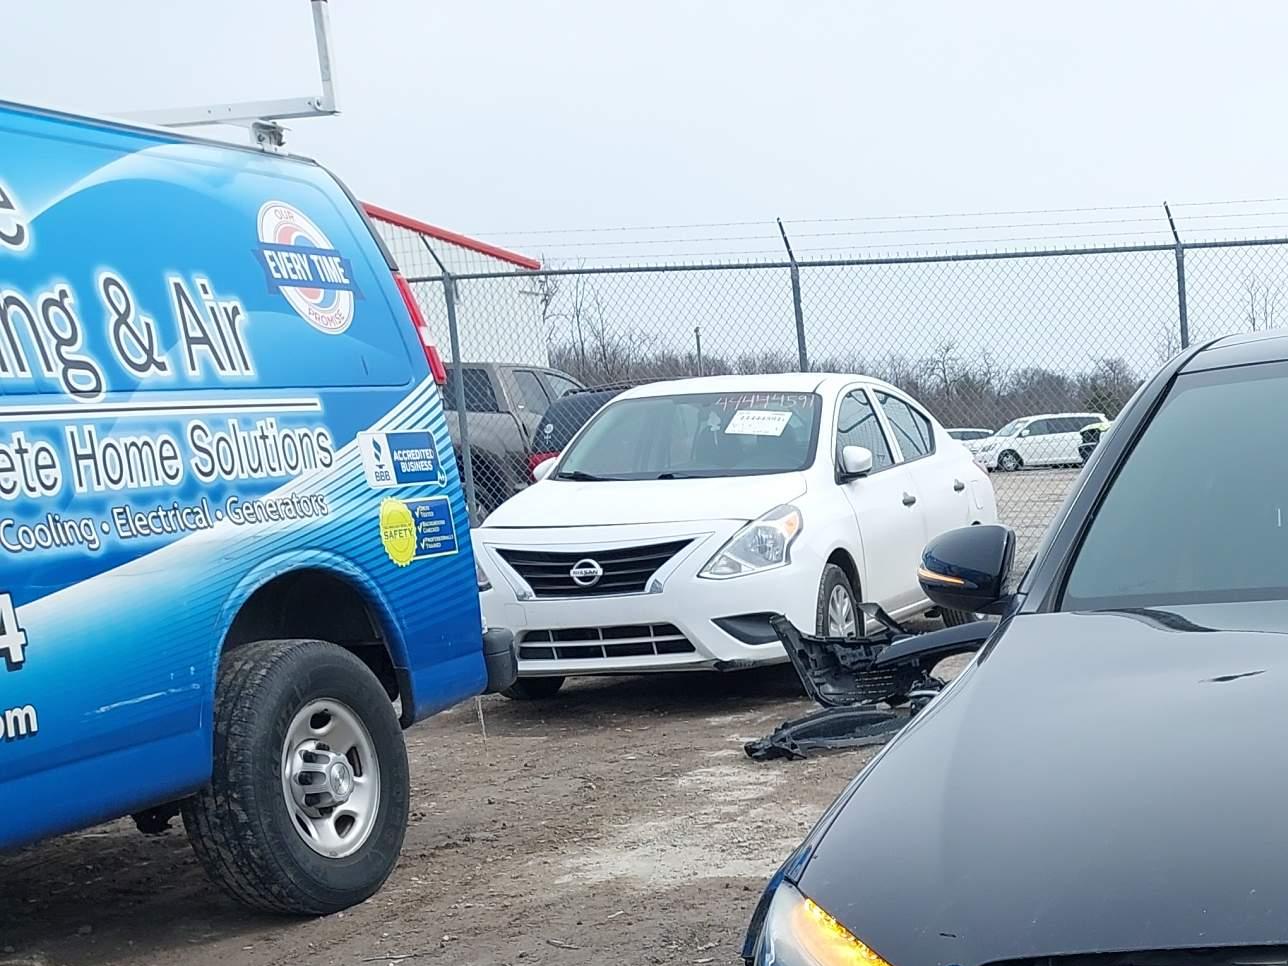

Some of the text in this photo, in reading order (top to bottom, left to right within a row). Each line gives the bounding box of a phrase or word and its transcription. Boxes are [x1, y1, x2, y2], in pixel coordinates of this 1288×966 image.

[274, 208, 295, 222] OUR
[263, 250, 350, 284] EVERY TIME
[103, 277, 167, 373] &
[173, 281, 251, 372] Air
[308, 307, 345, 327] PROMISE
[68, 429, 180, 488] Home
[190, 421, 334, 479] Solutions
[393, 449, 434, 462] ACCREDITED
[400, 460, 434, 473] BUSINESS
[374, 470, 391, 482] BBB
[1, 491, 329, 550] Cooling Electrical Generators
[384, 528, 413, 540] SAFETY
